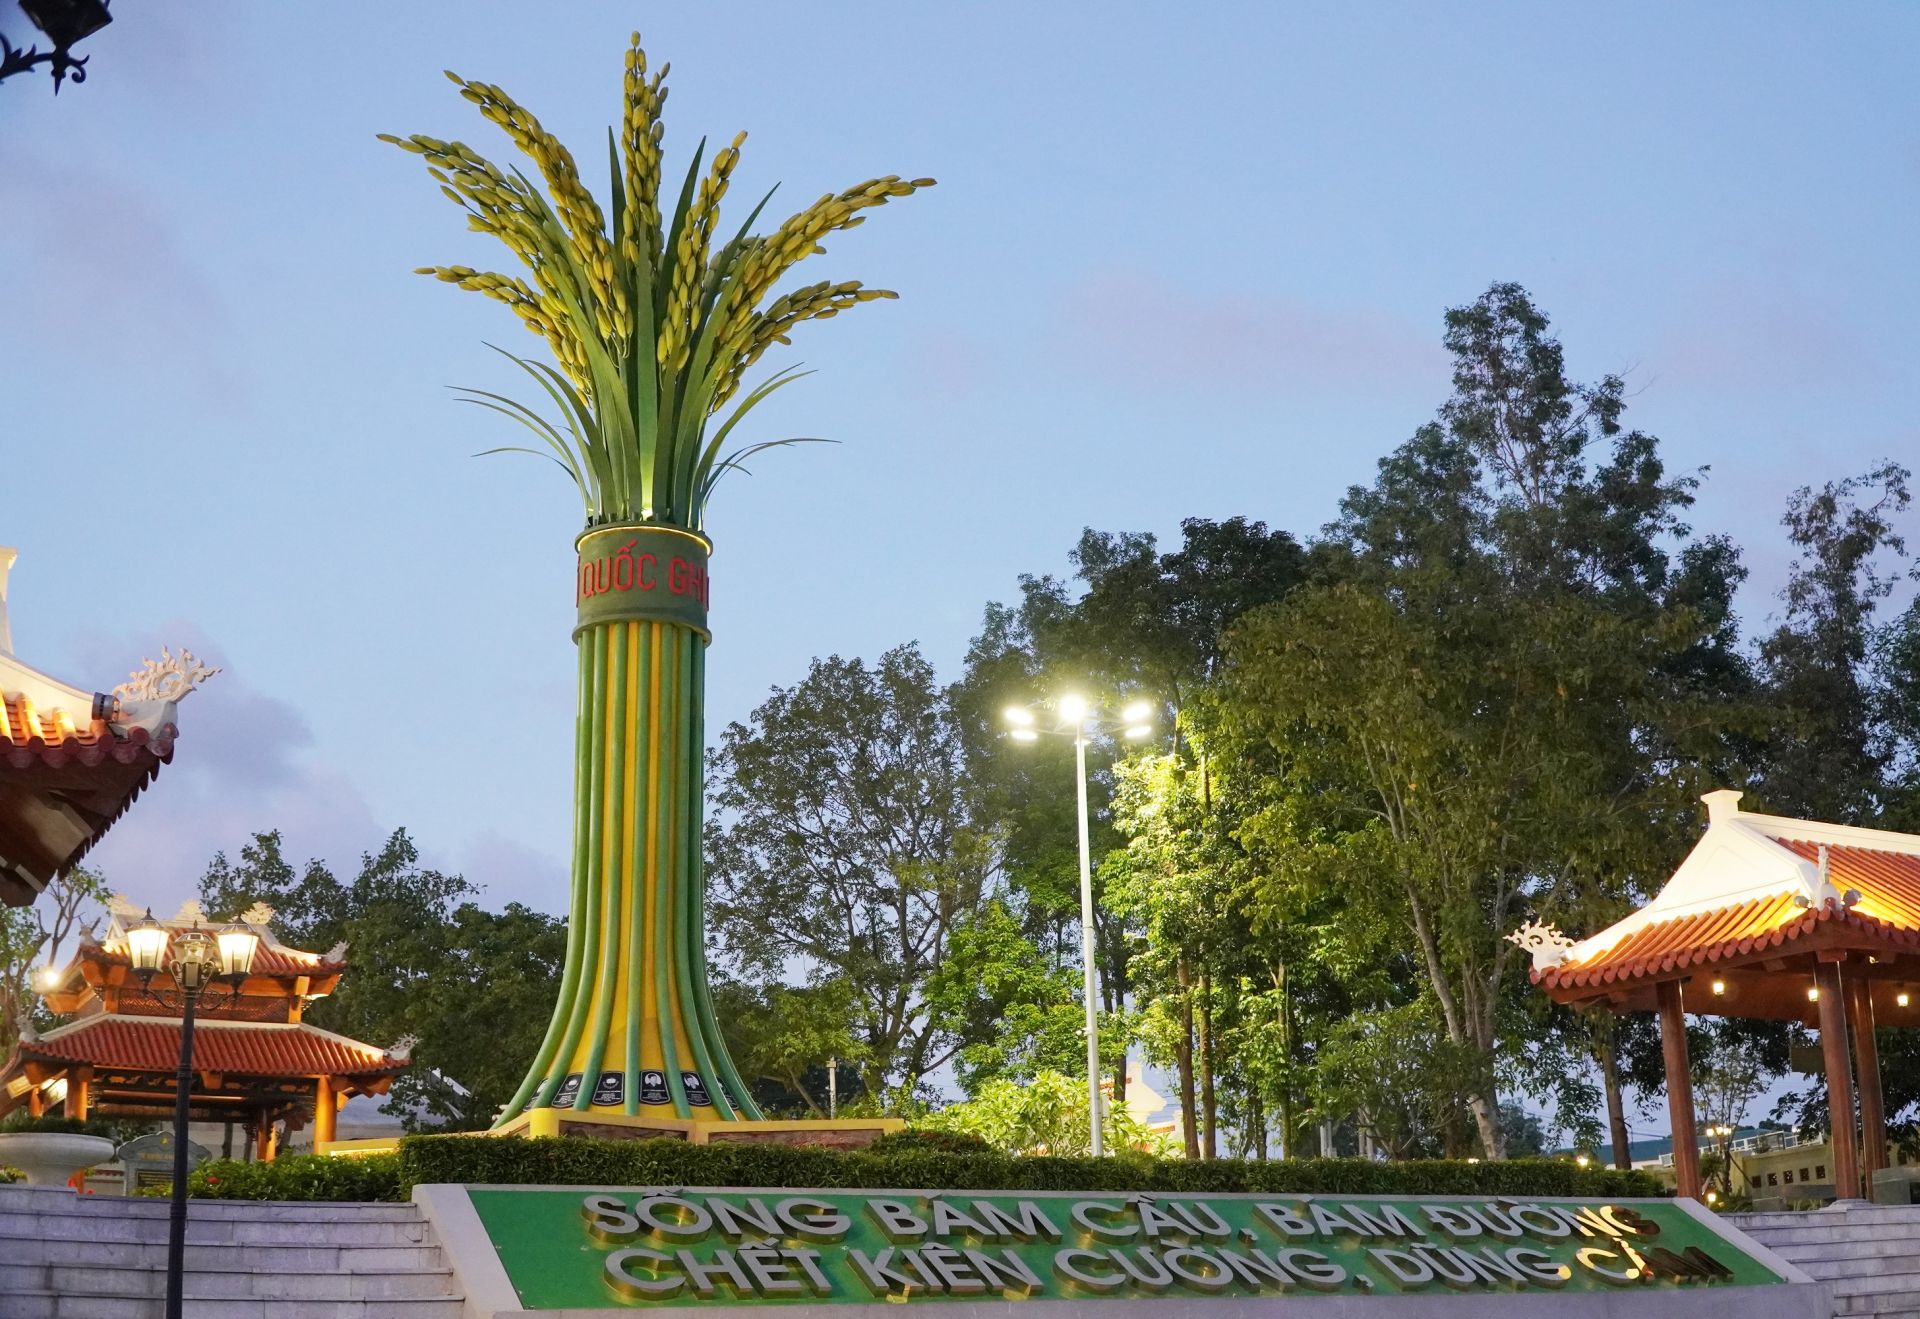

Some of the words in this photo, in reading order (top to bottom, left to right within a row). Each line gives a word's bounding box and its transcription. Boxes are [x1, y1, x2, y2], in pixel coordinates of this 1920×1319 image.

[583, 538, 657, 598] QUỐC
[581, 1186, 852, 1244] SỐNG
[864, 1193, 1063, 1244] BÁM
[1253, 1195, 1427, 1244] BÁM
[1418, 1197, 1661, 1244] ĐƯỜNG
[604, 1237, 832, 1299] CHẾT
[846, 1242, 1044, 1298] KIÊN
[1365, 1242, 1572, 1292] DŨNG
